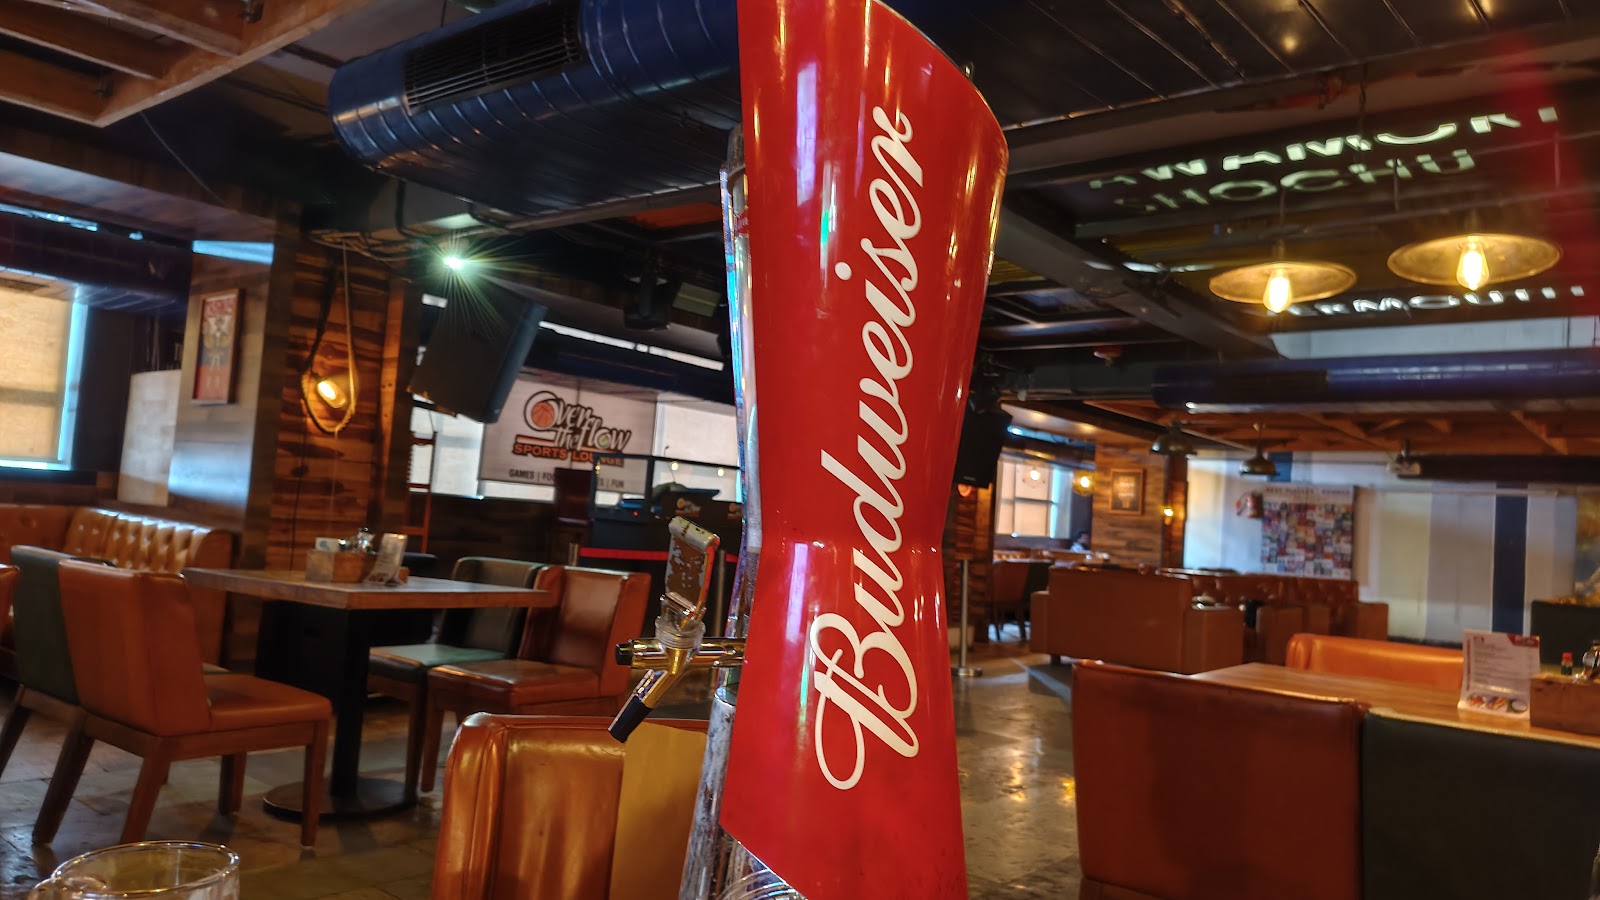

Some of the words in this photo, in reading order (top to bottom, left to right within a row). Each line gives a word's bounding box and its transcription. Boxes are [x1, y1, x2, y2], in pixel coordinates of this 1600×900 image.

[513, 443, 568, 460] SPORTS
[809, 106, 923, 791] Budweiser
[509, 468, 535, 480] GAMES
